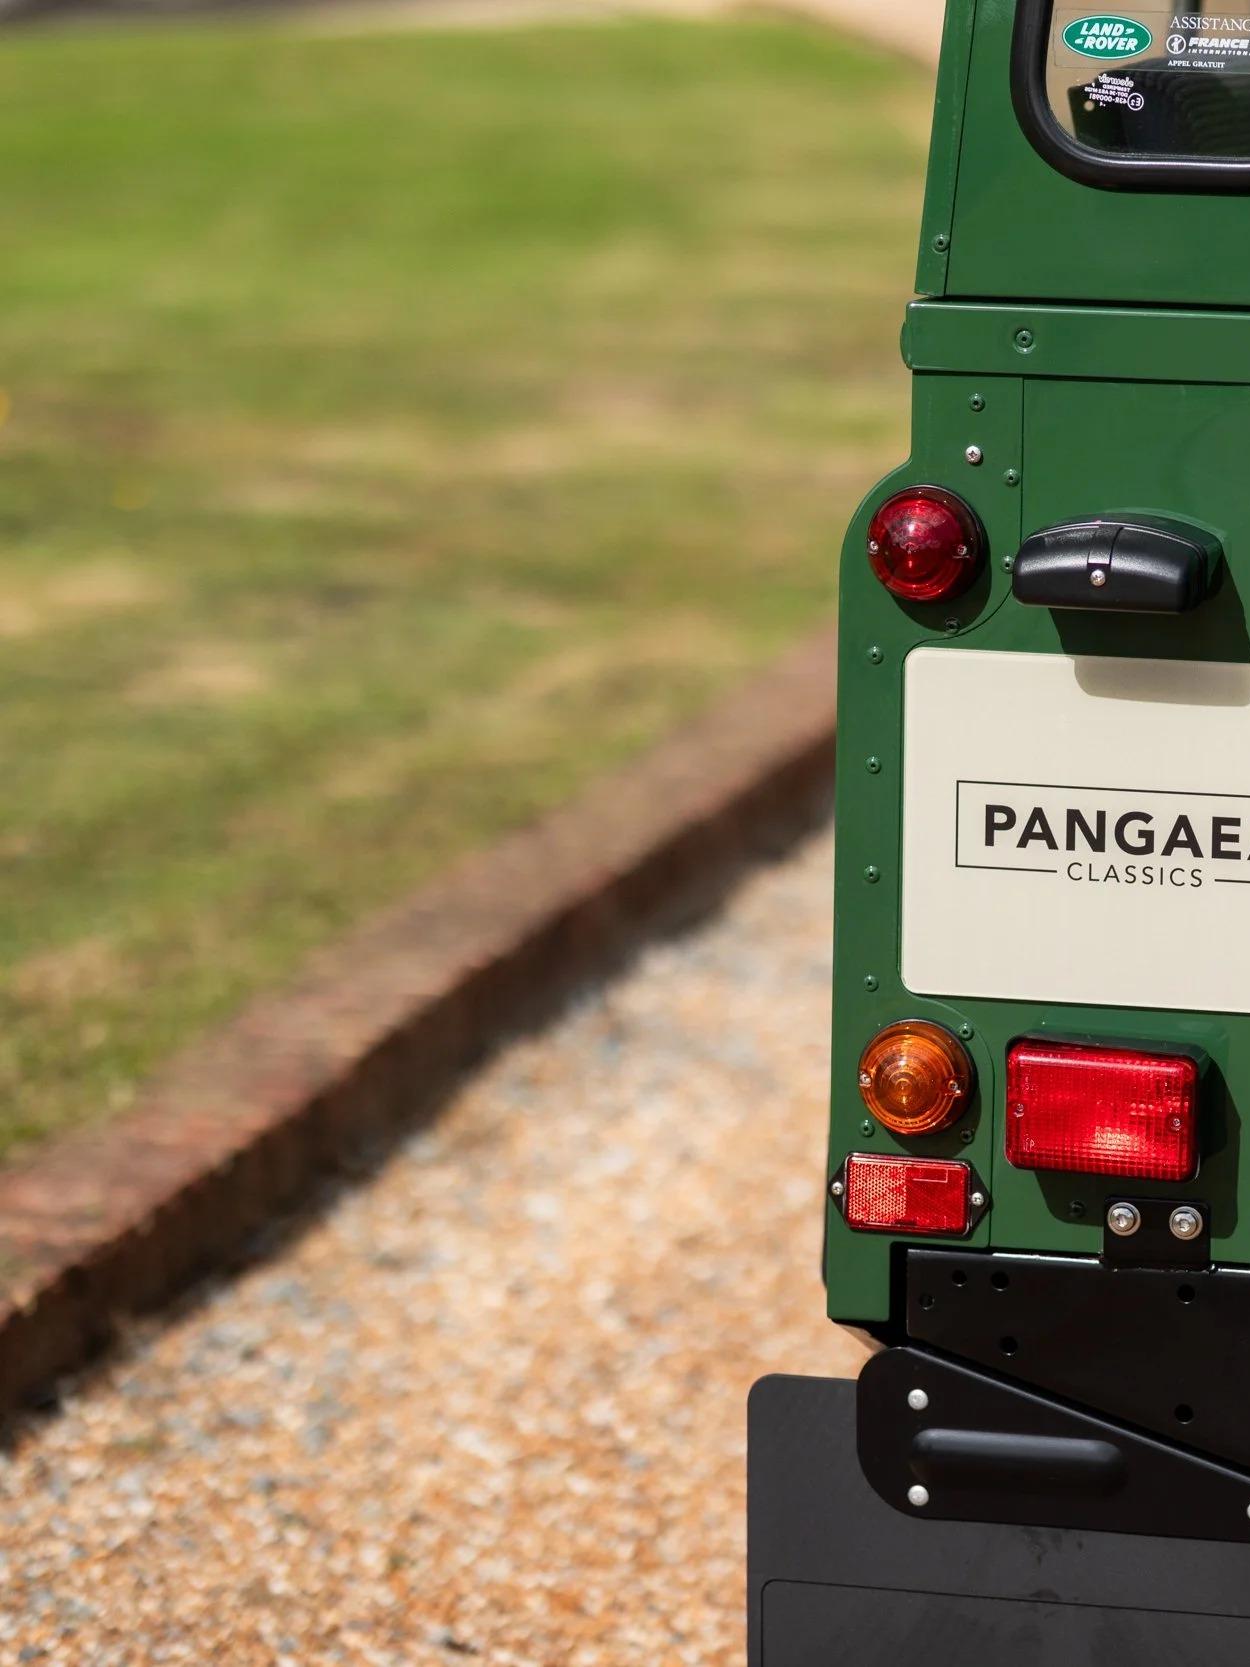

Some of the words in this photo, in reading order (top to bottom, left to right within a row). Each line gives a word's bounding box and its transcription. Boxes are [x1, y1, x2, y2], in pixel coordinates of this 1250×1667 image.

[1080, 22, 1125, 36] LAND
[1084, 36, 1138, 51] ROVER
[1188, 37, 1249, 48] FRANCE
[1066, 862, 1203, 888] CLASSICS
